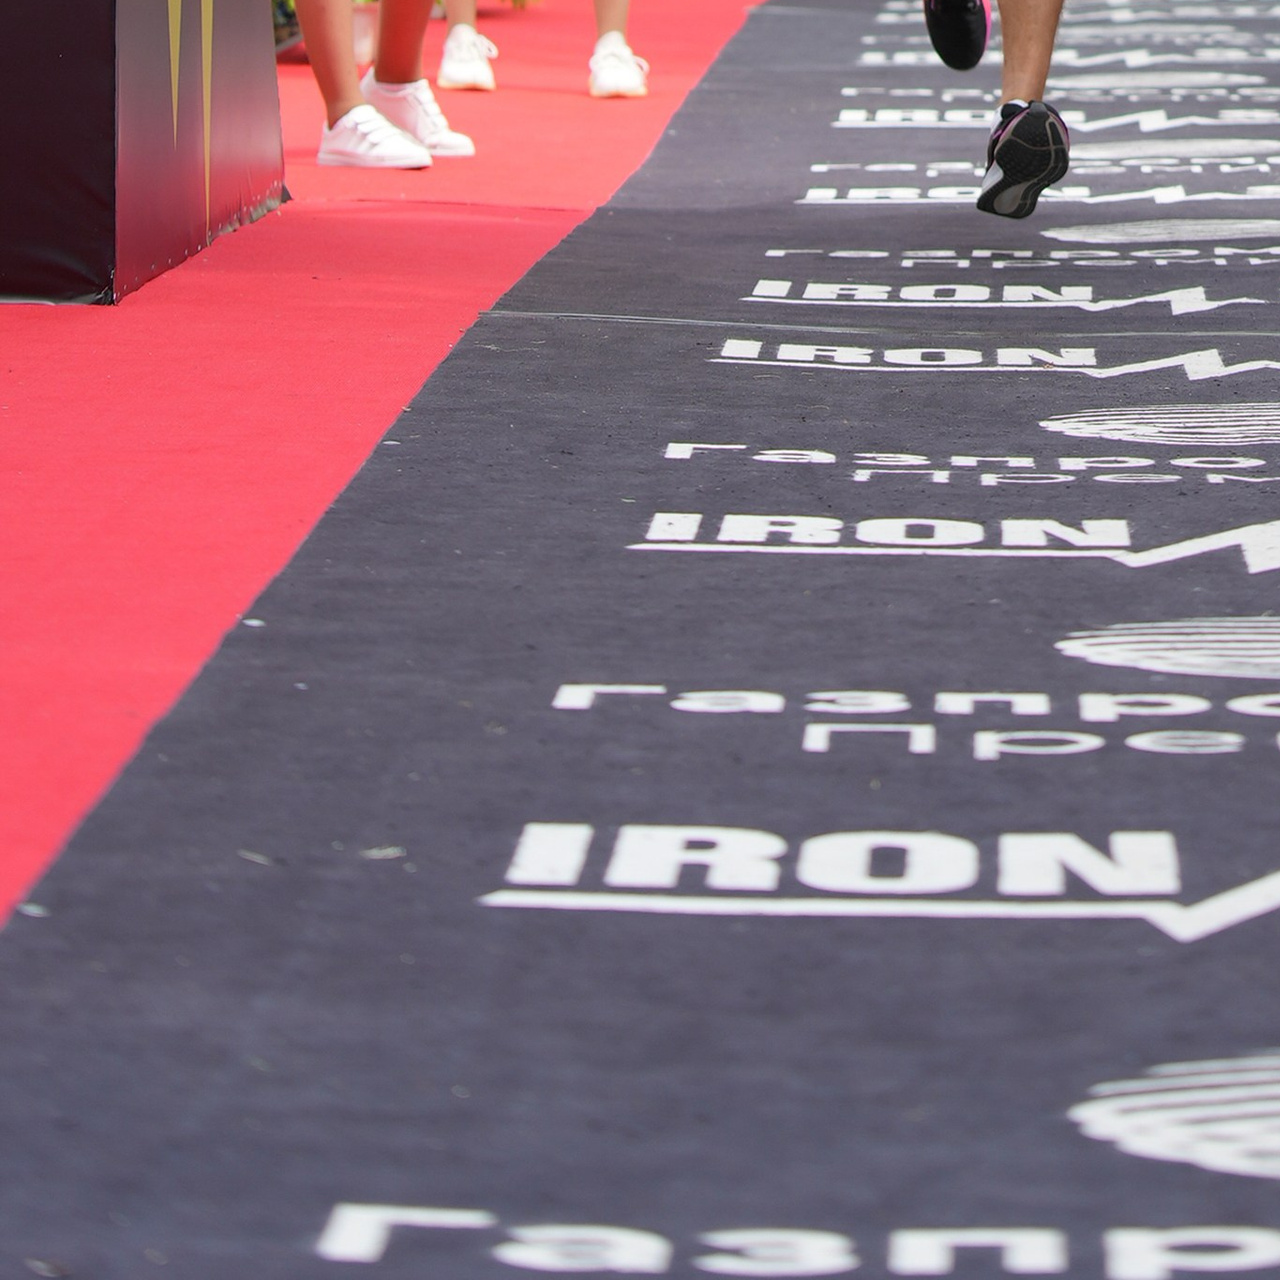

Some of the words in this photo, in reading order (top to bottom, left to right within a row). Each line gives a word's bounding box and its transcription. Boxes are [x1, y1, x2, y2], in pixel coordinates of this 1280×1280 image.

[752, 279, 1093, 302] IRON
[717, 339, 1098, 366] IRON
[646, 512, 1132, 547] IRON
[503, 821, 1181, 895] IRON
